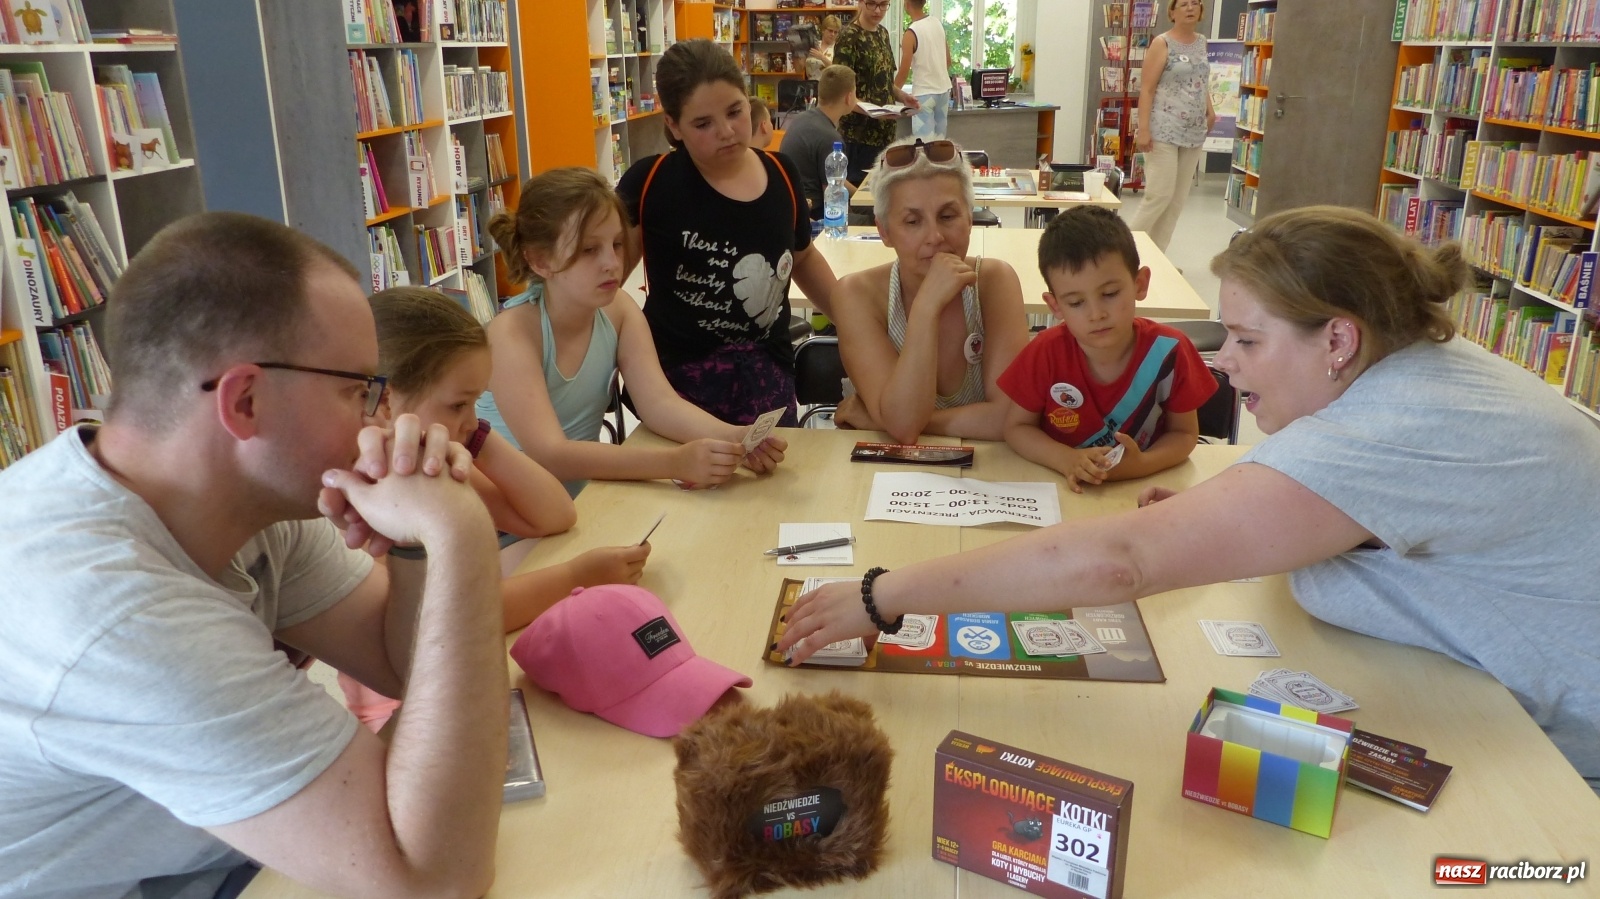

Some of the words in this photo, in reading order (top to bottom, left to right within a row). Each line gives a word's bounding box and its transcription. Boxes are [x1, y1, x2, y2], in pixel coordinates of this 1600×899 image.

[1398, 1, 1408, 18] LAT
[1238, 15, 1246, 40] LEKTURY
[1394, 17, 1404, 38] 8-11
[454, 147, 463, 178] HOBBY
[1467, 145, 1478, 164] LAT
[1463, 163, 1474, 186] 8-11
[1409, 199, 1420, 218] LAT
[682, 230, 718, 252] There
[723, 241, 739, 256] is
[707, 256, 729, 268] no
[373, 273, 381, 294] SPO
[675, 264, 726, 295] beauty
[1578, 260, 1594, 300] BAŚNIE
[23, 259, 44, 323] DINOZAURY
[674, 289, 733, 314] without
[891, 490, 932, 498] 20:00
[948, 499, 990, 508] 13:00
[995, 494, 1037, 504] Godz.
[885, 508, 959, 518] PREZENTACJE
[889, 500, 931, 508] 15:00
[995, 501, 1038, 512] Godz.
[968, 508, 1042, 521] REZERWACJA
[976, 661, 1042, 672] NIEDŹWIEDZIE
[1352, 737, 1390, 755] DŹWIEDZIE
[1000, 751, 1035, 769] KOTKI
[1035, 762, 1124, 796] EKSPLODUJĄCE
[763, 794, 821, 815] NIEDŹWIEDZIE
[945, 761, 1056, 815] EKSPLODUJĄCE
[1060, 800, 1107, 831] KOTKI
[1184, 789, 1220, 805] NIEDŹWIEDZIE
[1227, 802, 1249, 813] BOBASY
[786, 812, 796, 821] VS
[1056, 818, 1082, 830] EUREKA
[764, 816, 820, 841] BOBASY
[936, 836, 950, 846] WIEK
[1055, 833, 1100, 863] 302
[991, 850, 1000, 858] DLA
[992, 840, 1008, 852] GRA
[1008, 845, 1047, 867] KARCIANA
[991, 857, 1009, 871] KOTY
[1012, 864, 1046, 883] WYBUCHY
[1009, 872, 1029, 885] LASERY
